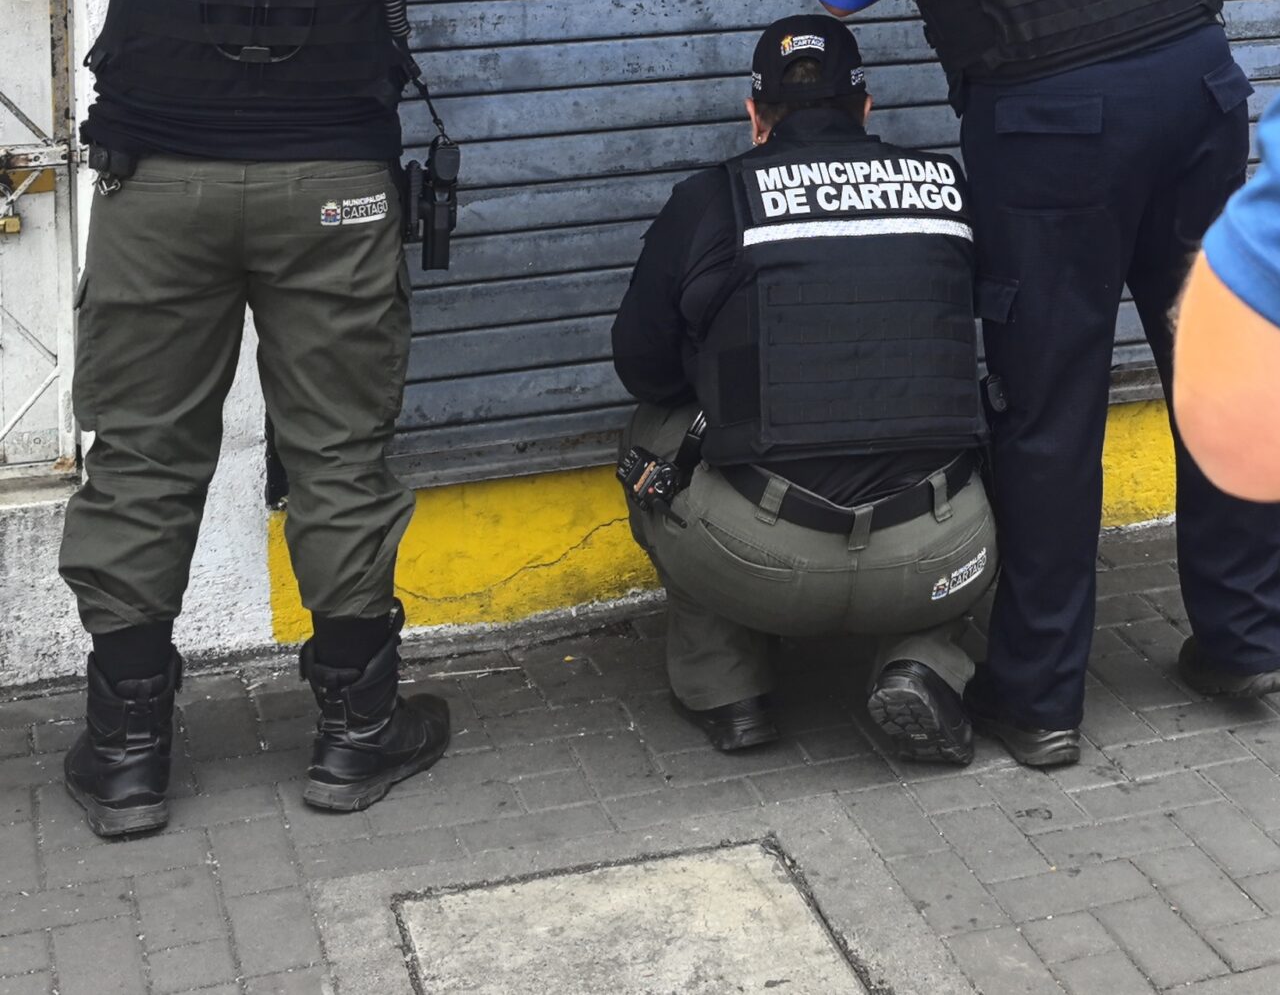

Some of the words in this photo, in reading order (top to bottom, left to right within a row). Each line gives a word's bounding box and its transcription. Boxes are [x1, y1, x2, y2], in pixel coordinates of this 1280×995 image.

[755, 158, 956, 192] MUNICIPALIDAD
[342, 192, 387, 207] MUNICIPALIDAD
[342, 200, 389, 219] CARTAGO
[761, 189, 811, 218] DE
[816, 183, 962, 213] CARTAGO
[949, 554, 987, 589] CARTAGO
